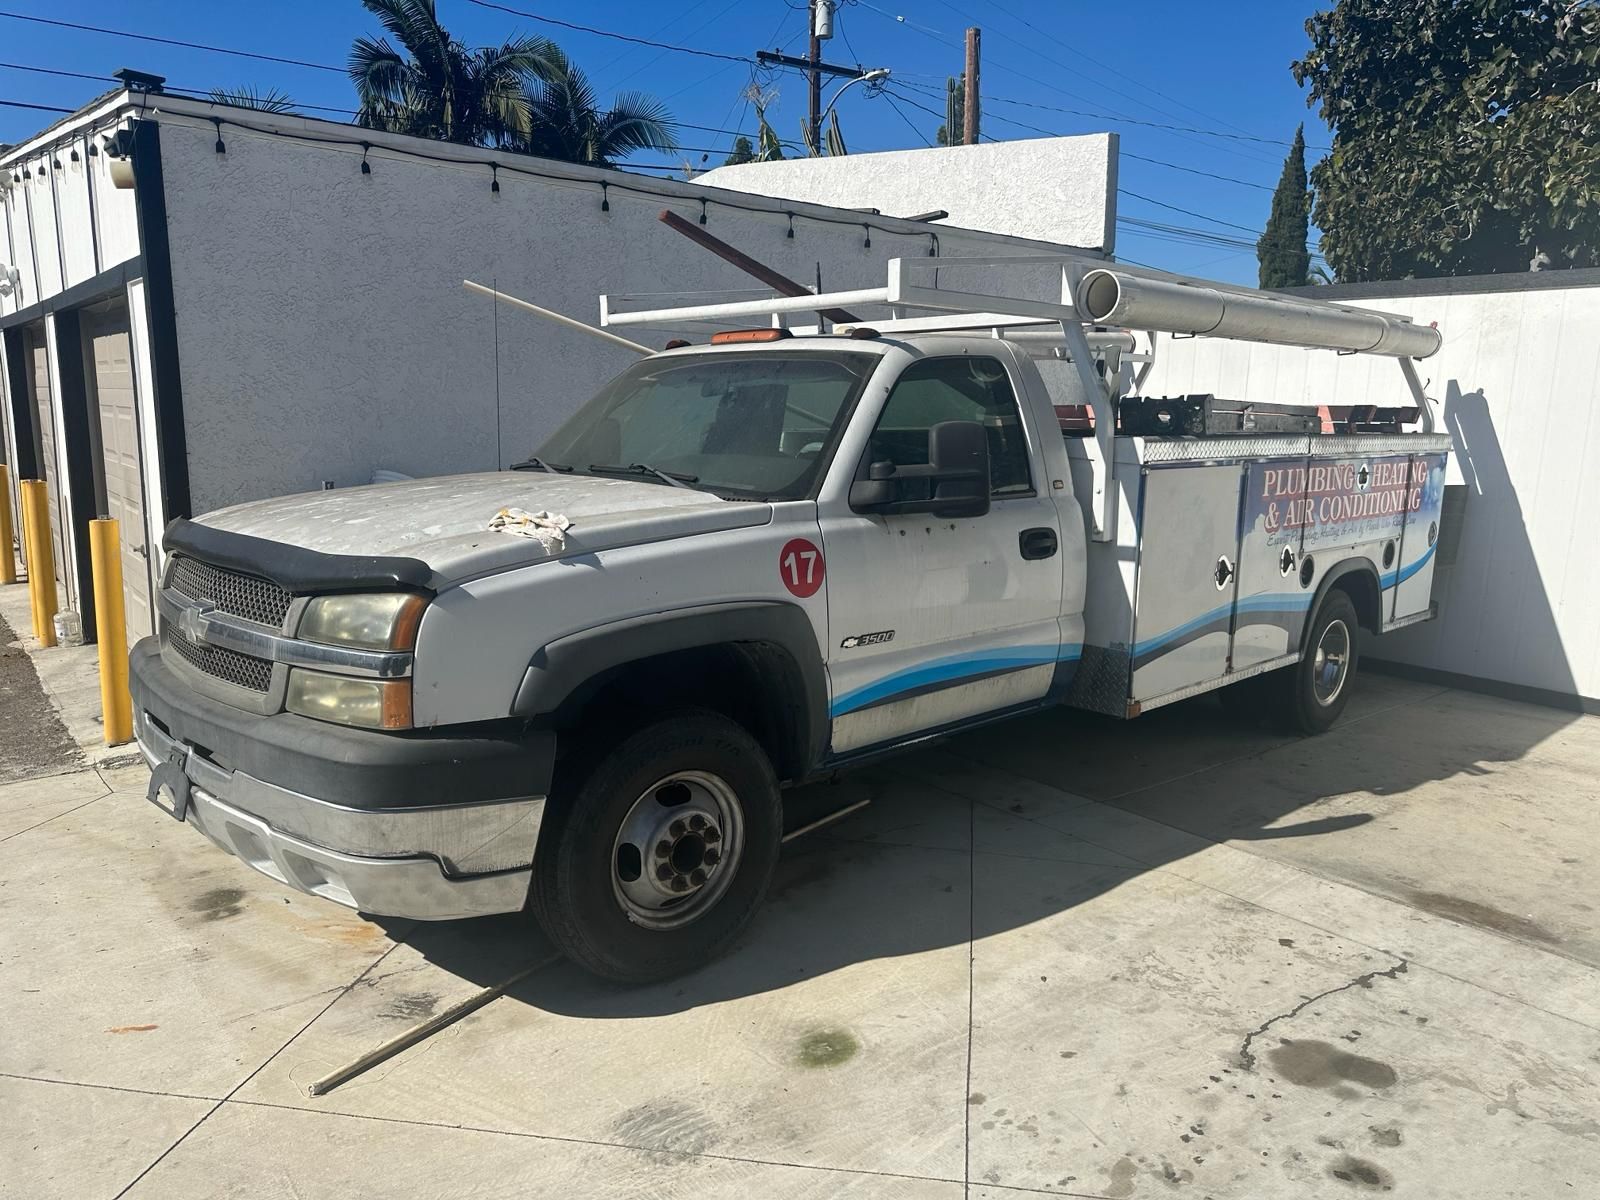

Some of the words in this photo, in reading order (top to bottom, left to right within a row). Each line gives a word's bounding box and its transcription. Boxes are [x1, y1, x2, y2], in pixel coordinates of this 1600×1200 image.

[1262, 464, 1355, 497] PLUMBING
[1371, 461, 1427, 487] HEATING
[1264, 502, 1280, 530] &
[1283, 498, 1314, 526] AIR
[1319, 488, 1421, 522] CONDITIONING
[784, 550, 817, 586] 17
[861, 631, 895, 647] 3500
